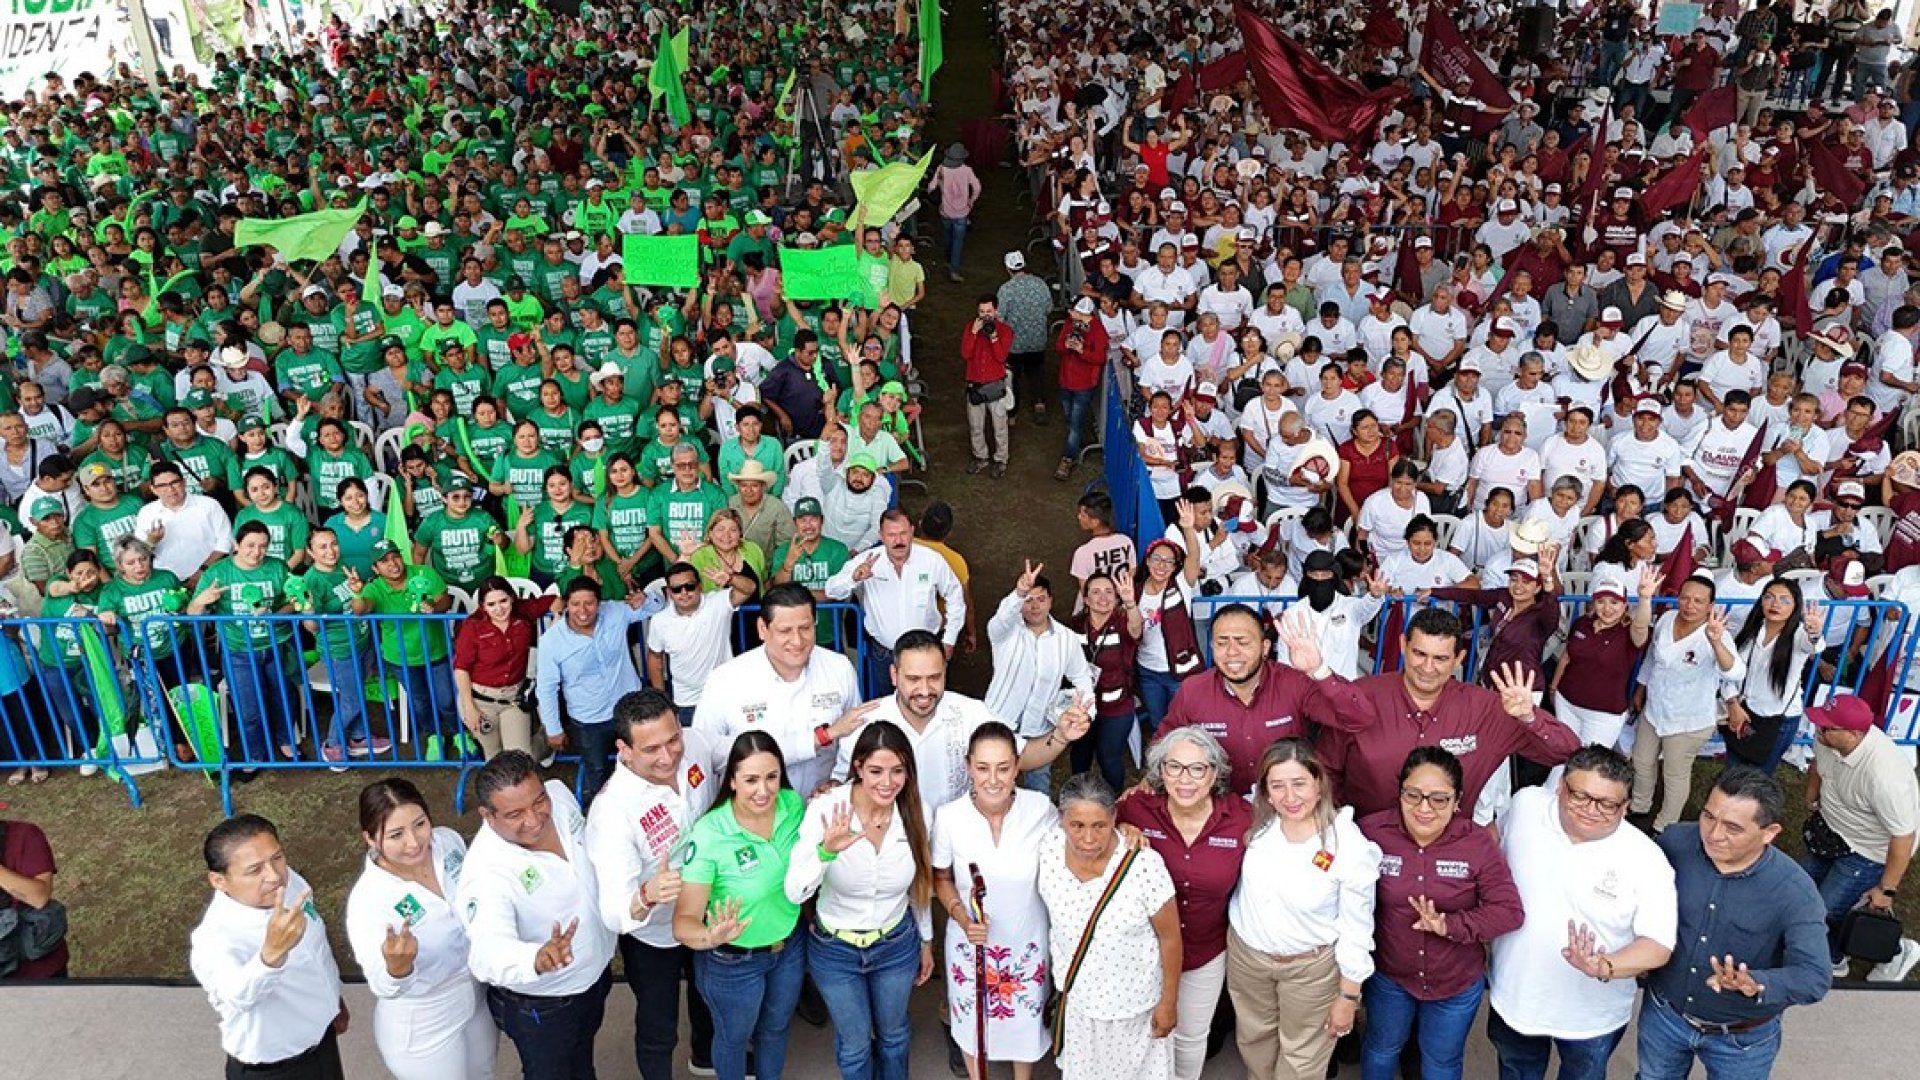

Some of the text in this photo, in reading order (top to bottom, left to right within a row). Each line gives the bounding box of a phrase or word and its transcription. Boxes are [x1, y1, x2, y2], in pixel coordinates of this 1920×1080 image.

[509, 468, 543, 484] RUTH
[611, 507, 647, 525] RUTH
[669, 502, 703, 518] RUTH
[441, 527, 479, 546] RUTH
[1093, 544, 1131, 567] HEY
[793, 560, 829, 581] RUTH
